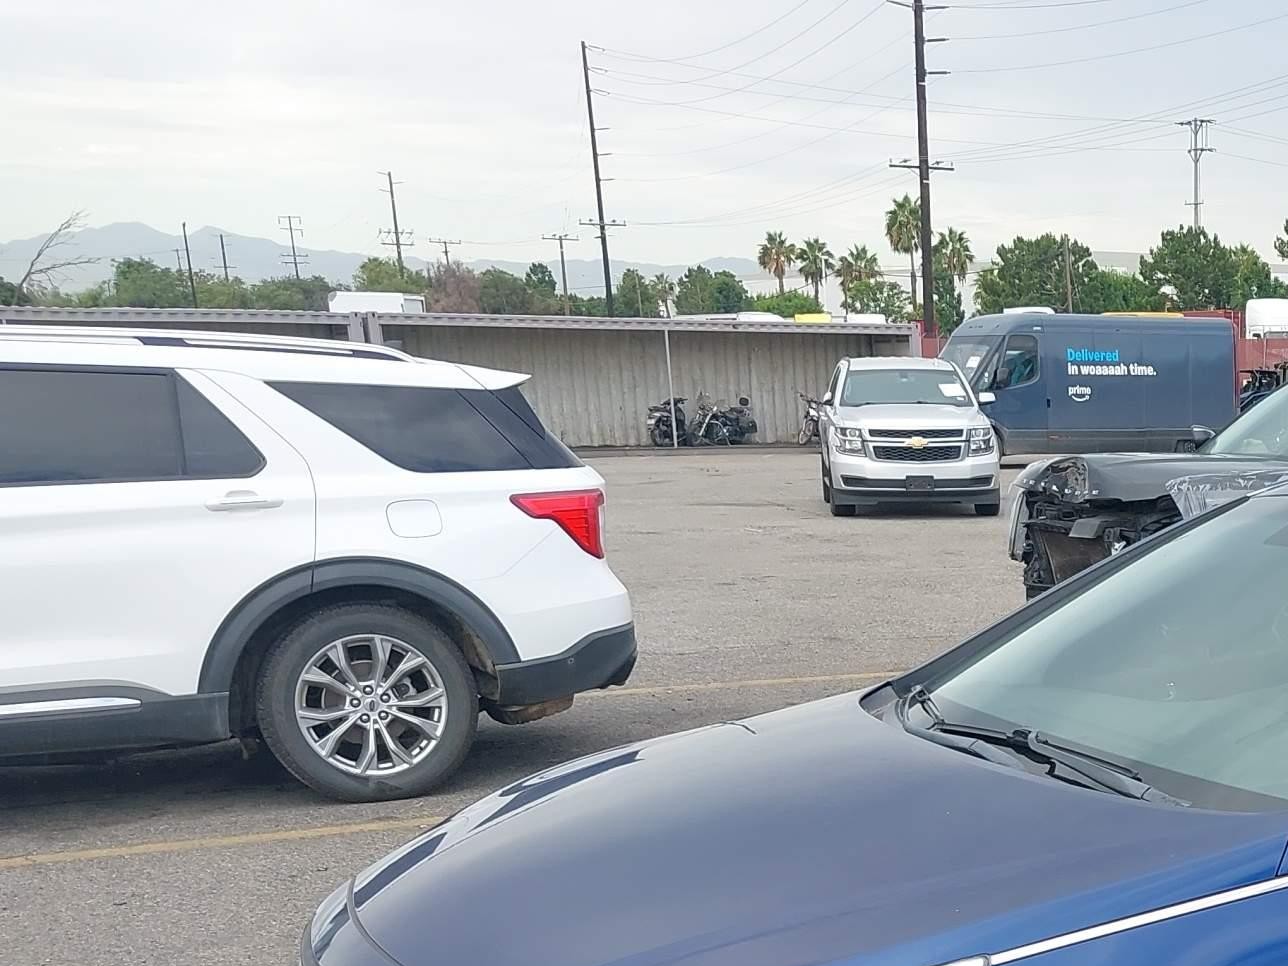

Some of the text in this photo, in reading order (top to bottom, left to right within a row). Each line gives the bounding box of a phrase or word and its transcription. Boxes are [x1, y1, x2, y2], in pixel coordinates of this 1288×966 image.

[1067, 348, 1119, 362] Delivered
[1067, 362, 1157, 376] in woaaaah time.
[1068, 384, 1092, 396] prime
